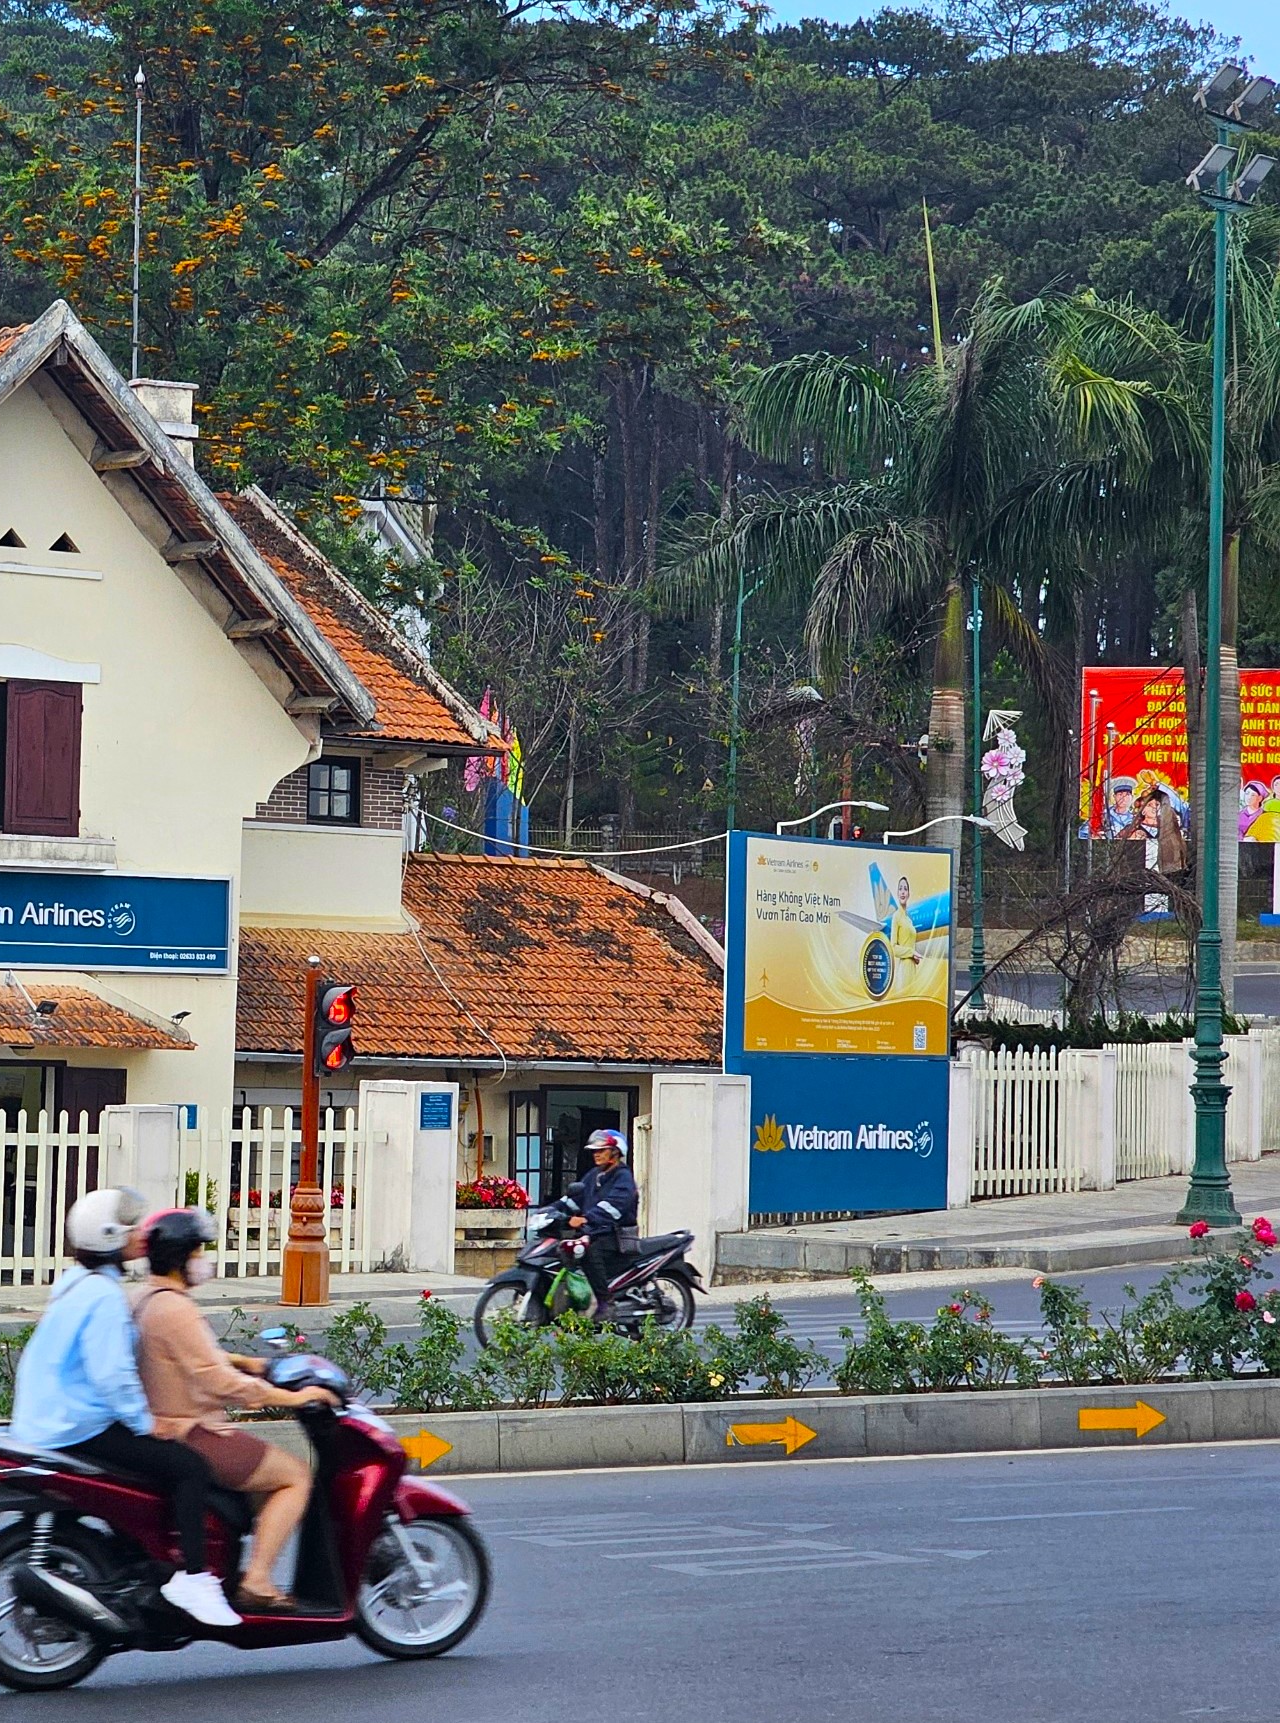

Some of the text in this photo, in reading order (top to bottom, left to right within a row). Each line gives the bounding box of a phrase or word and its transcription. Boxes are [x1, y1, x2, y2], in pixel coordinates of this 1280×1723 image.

[1145, 749, 1168, 764] VIỆT
[756, 889, 841, 908] Hàng Không Việt Nam
[20, 902, 104, 928] Airlines
[799, 911, 814, 922] Cao
[786, 1124, 914, 1150] Vietnam Airlines
